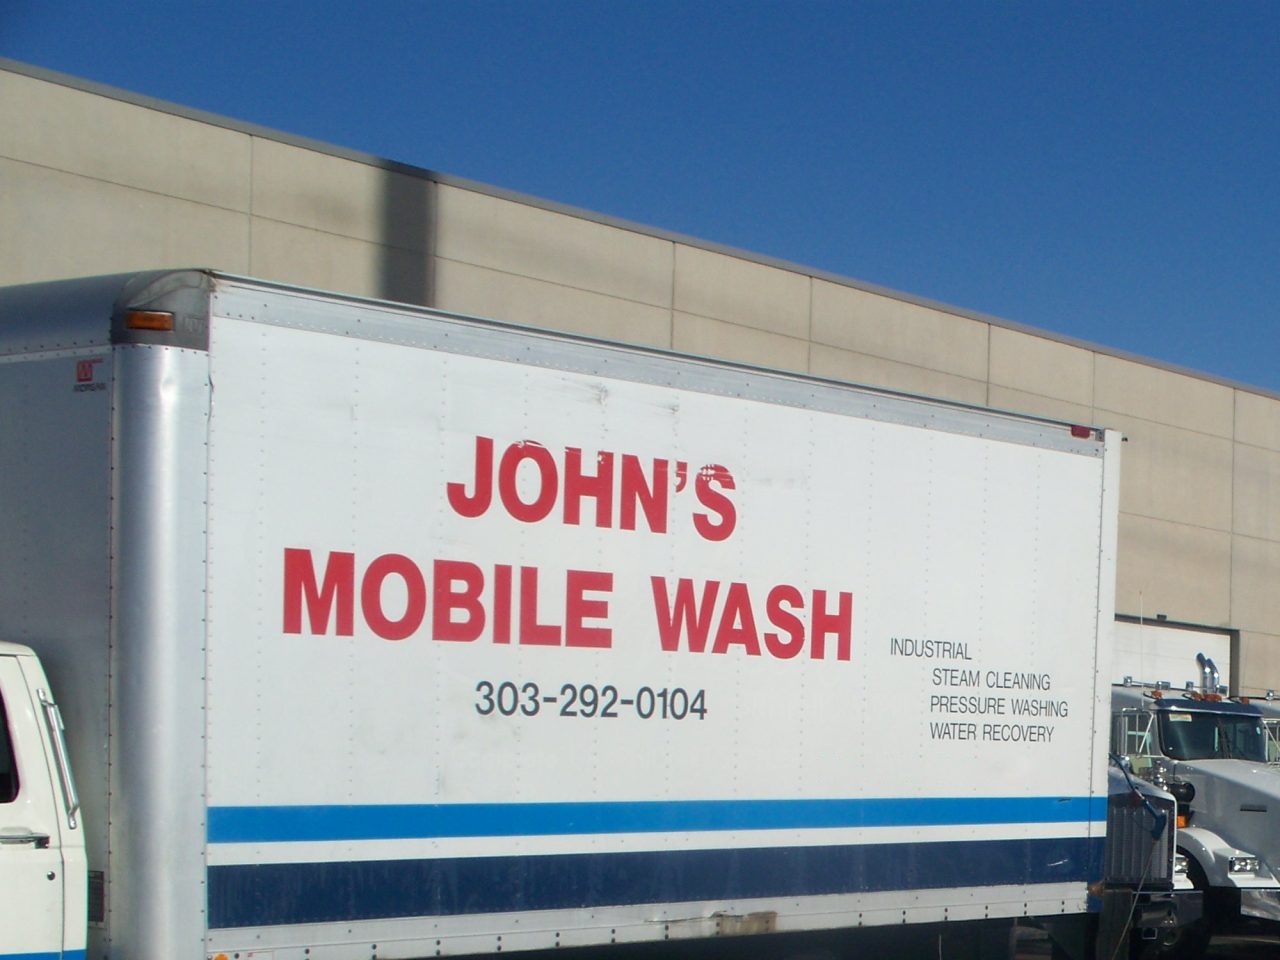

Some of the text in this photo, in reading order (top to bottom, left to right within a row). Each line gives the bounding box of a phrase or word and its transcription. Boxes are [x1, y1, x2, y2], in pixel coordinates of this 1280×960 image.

[447, 436, 736, 542] JOHN'S
[283, 548, 853, 661] MOBILE WASH
[890, 638, 972, 660] INDUSTRIAL
[932, 668, 1051, 690] STEAM CLEANING
[475, 681, 707, 720] 303-292-0104
[930, 696, 1068, 717] PRESSURE WASHING
[930, 722, 1054, 742] WATER RECOVERY
